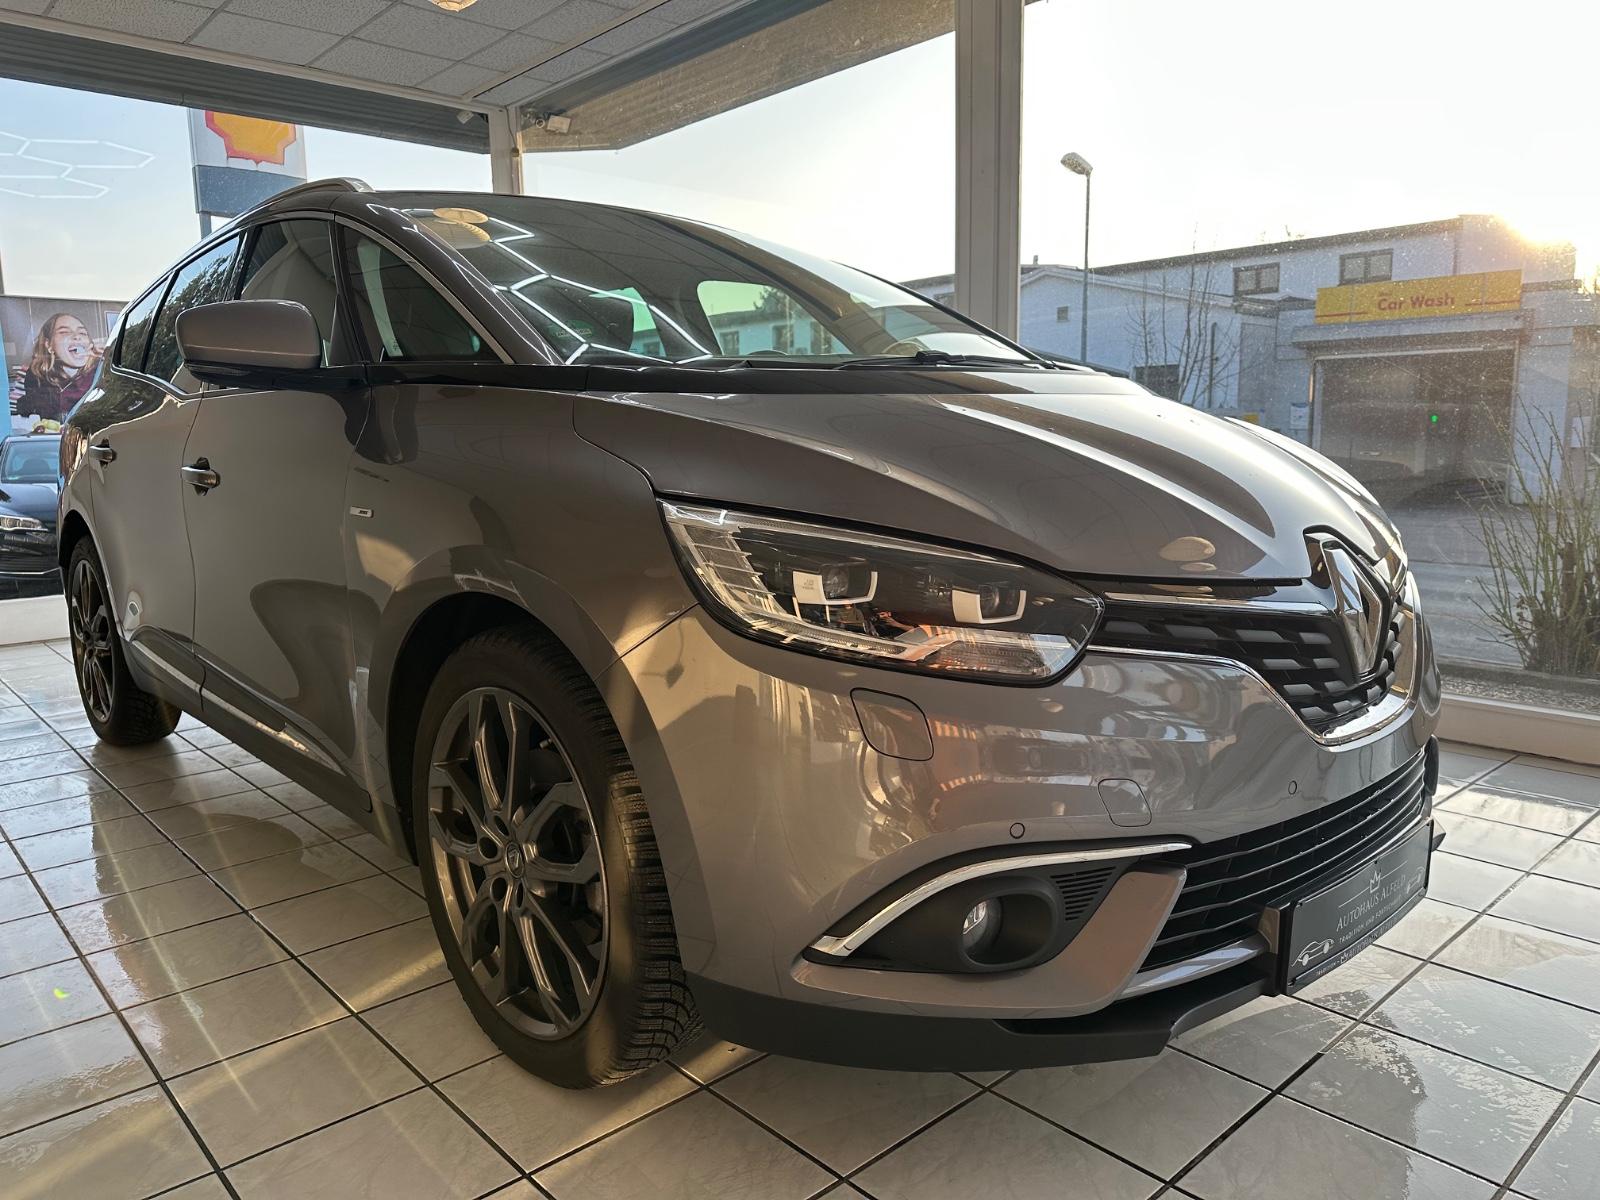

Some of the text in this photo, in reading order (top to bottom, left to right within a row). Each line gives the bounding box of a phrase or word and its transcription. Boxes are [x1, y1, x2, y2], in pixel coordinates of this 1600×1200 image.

[1377, 292, 1455, 311] Car Wash
[1336, 892, 1380, 932] AUTOHAUS
